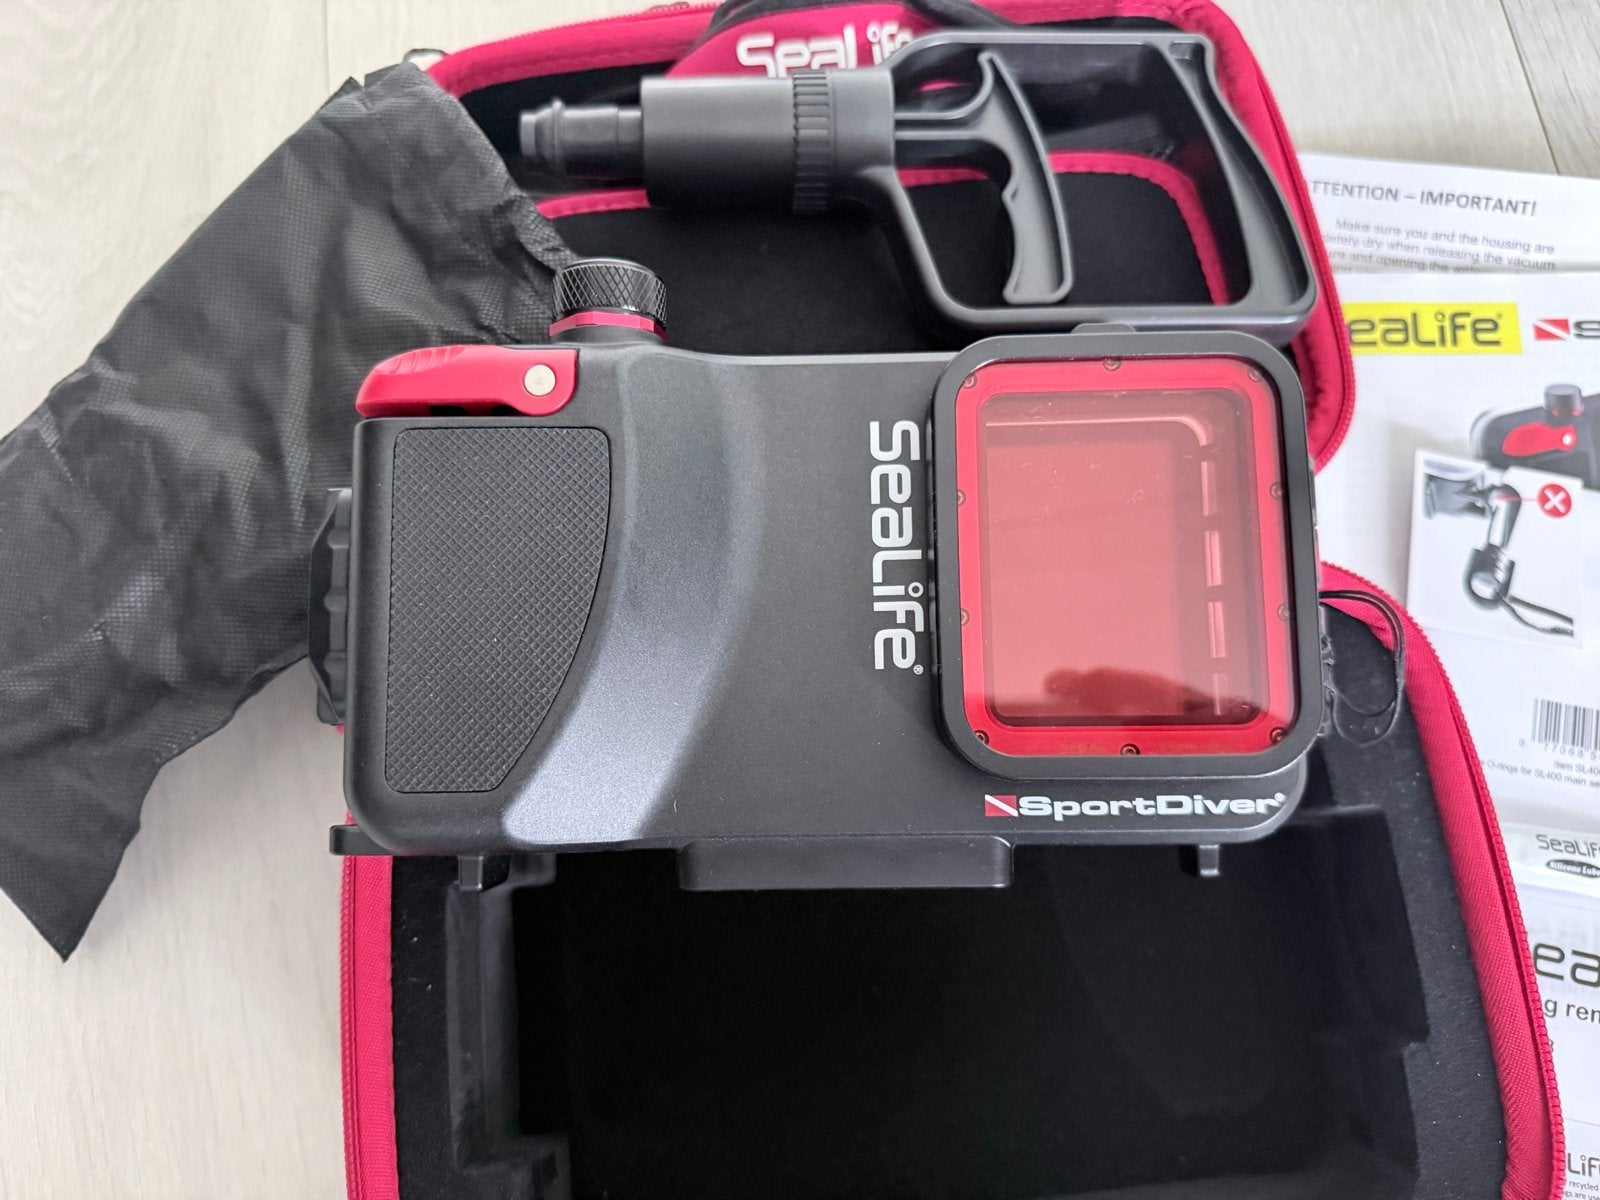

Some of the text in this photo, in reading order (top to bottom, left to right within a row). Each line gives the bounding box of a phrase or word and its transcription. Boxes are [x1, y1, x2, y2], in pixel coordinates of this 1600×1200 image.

[1420, 190, 1538, 217] IMPORTANT!
[1335, 219, 1554, 255] Make sure you and the housing are
[1349, 251, 1373, 263] and
[1376, 256, 1426, 271] opening
[1363, 237, 1383, 251] dry
[1387, 240, 1420, 254] when
[1423, 245, 1480, 265] releasing
[1484, 251, 1503, 265] the
[1507, 257, 1556, 271] vacuum
[1535, 834, 1600, 857] SeaLif
[1567, 1153, 1600, 1177] Lif
